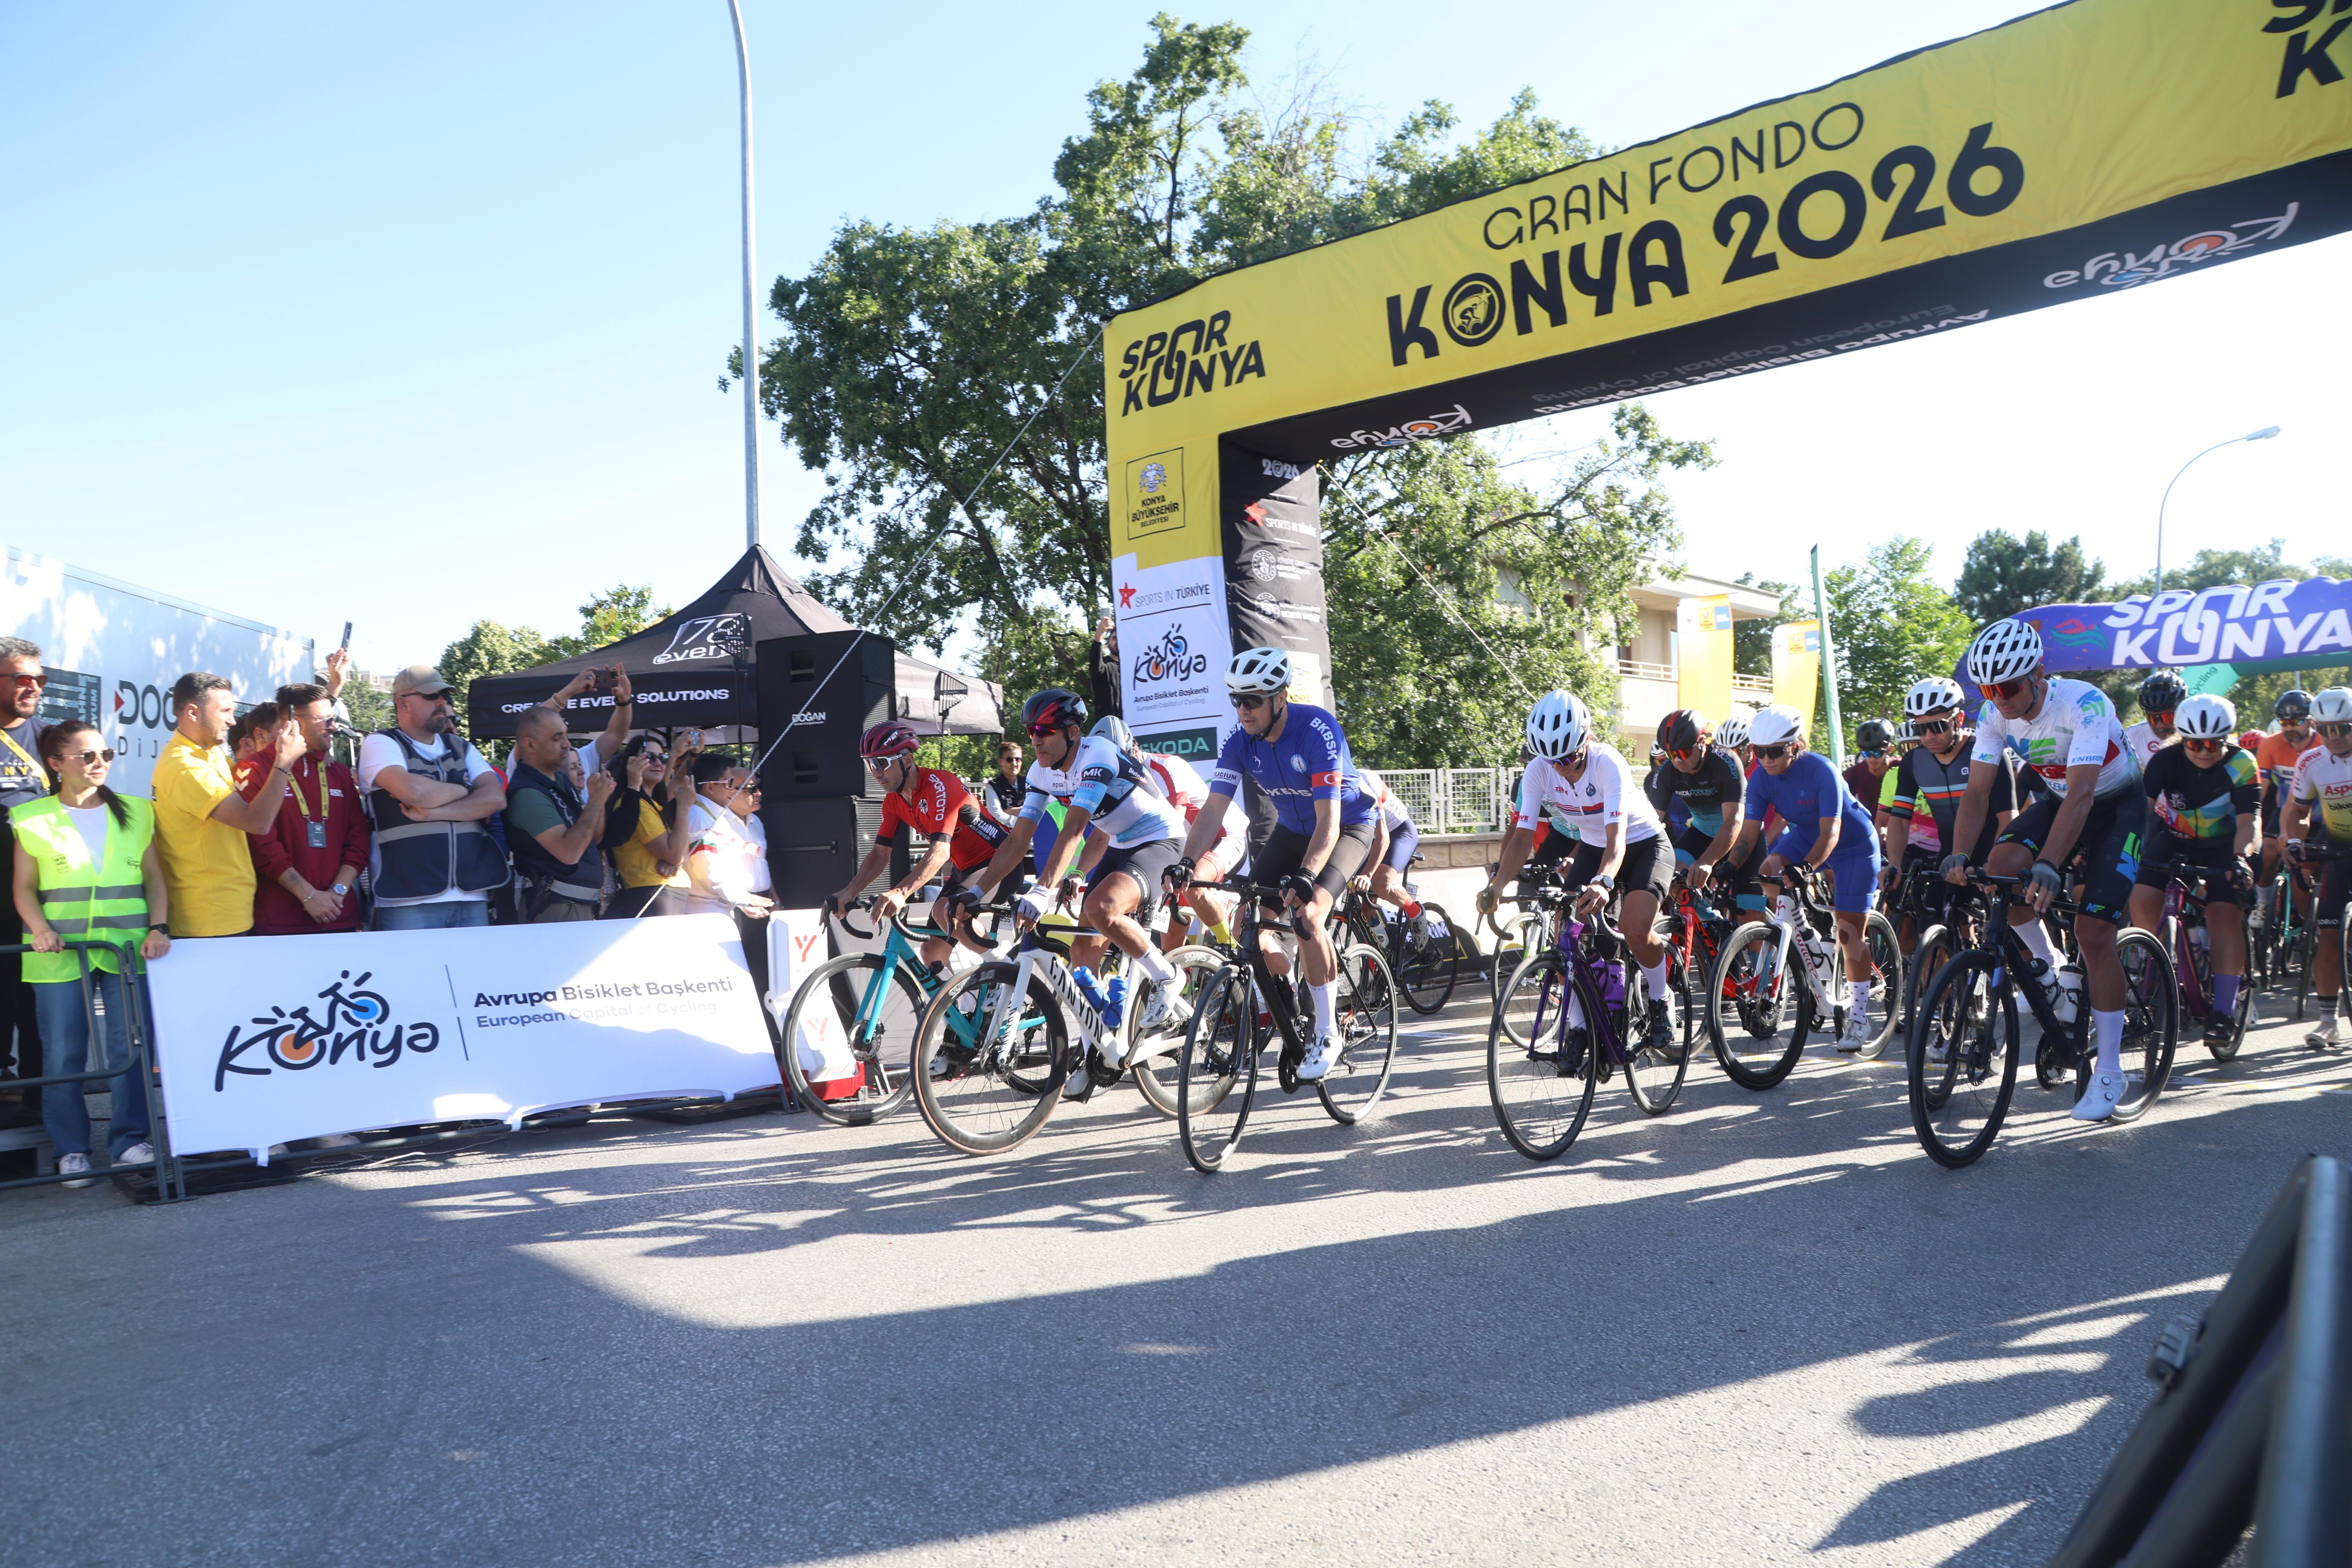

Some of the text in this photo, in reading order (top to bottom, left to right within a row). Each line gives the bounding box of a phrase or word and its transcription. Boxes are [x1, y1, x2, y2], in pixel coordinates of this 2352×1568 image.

[1484, 102, 1865, 250] GRAN FONDO
[1386, 121, 2024, 367] KONYA 2026
[1118, 310, 1232, 379] SPOR
[1531, 303, 1957, 403] European Capital of Cycling
[1532, 309, 1991, 414] Avrupa Bisiklet Başkenti
[1121, 340, 1266, 417] KONYA
[1261, 458, 1300, 481] 2026
[1131, 501, 1180, 522] BÜYÜKŞEHİR
[1141, 494, 1166, 507] KONYA
[1140, 515, 1169, 528] BELEDİYESİ
[1266, 517, 1291, 531] SPORTS
[1135, 583, 1210, 607] SPORTS IN TÜRKİYE
[2103, 579, 2299, 634] SPOR
[2112, 607, 2352, 666] KONYA
[654, 645, 735, 664] even
[637, 689, 729, 704] SOLUTIONS
[1133, 686, 1209, 704] Avrupa Bisiklet Başkenti
[883, 730, 899, 747] MET
[1309, 717, 1338, 761] BKBSK
[928, 774, 946, 821] SPORTOTO
[1131, 869, 1148, 899] TREK
[1153, 914, 1166, 923] 458
[474, 976, 733, 1008] Avrupa Bisiklet Başkenti
[1049, 956, 1103, 1044] CANYON
[476, 1010, 566, 1028] European
[569, 1004, 633, 1021] Capital
[656, 1001, 718, 1015] Cycling
[214, 1021, 440, 1093] Konya
